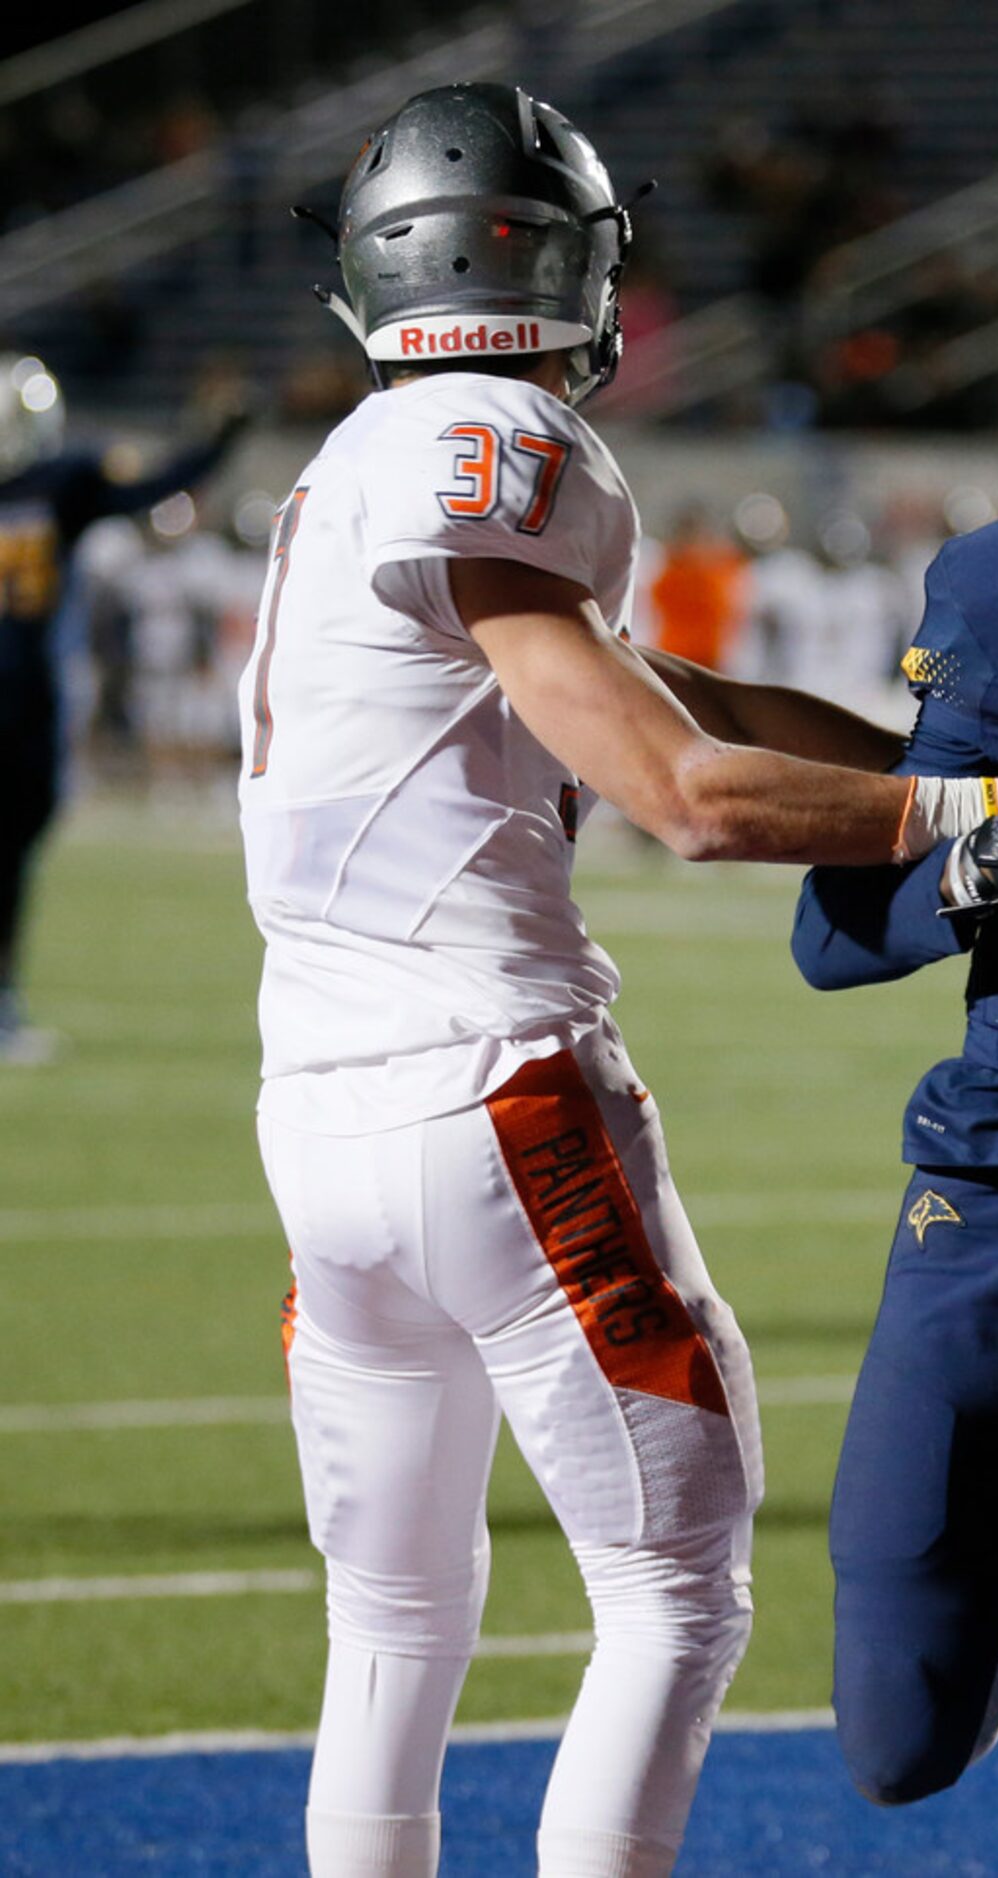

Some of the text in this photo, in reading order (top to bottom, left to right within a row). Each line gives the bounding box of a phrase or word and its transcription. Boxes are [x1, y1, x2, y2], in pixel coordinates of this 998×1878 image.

[400, 322, 541, 356] Riddell
[435, 421, 571, 536] 37
[521, 1127, 668, 1347] PANTHERS
